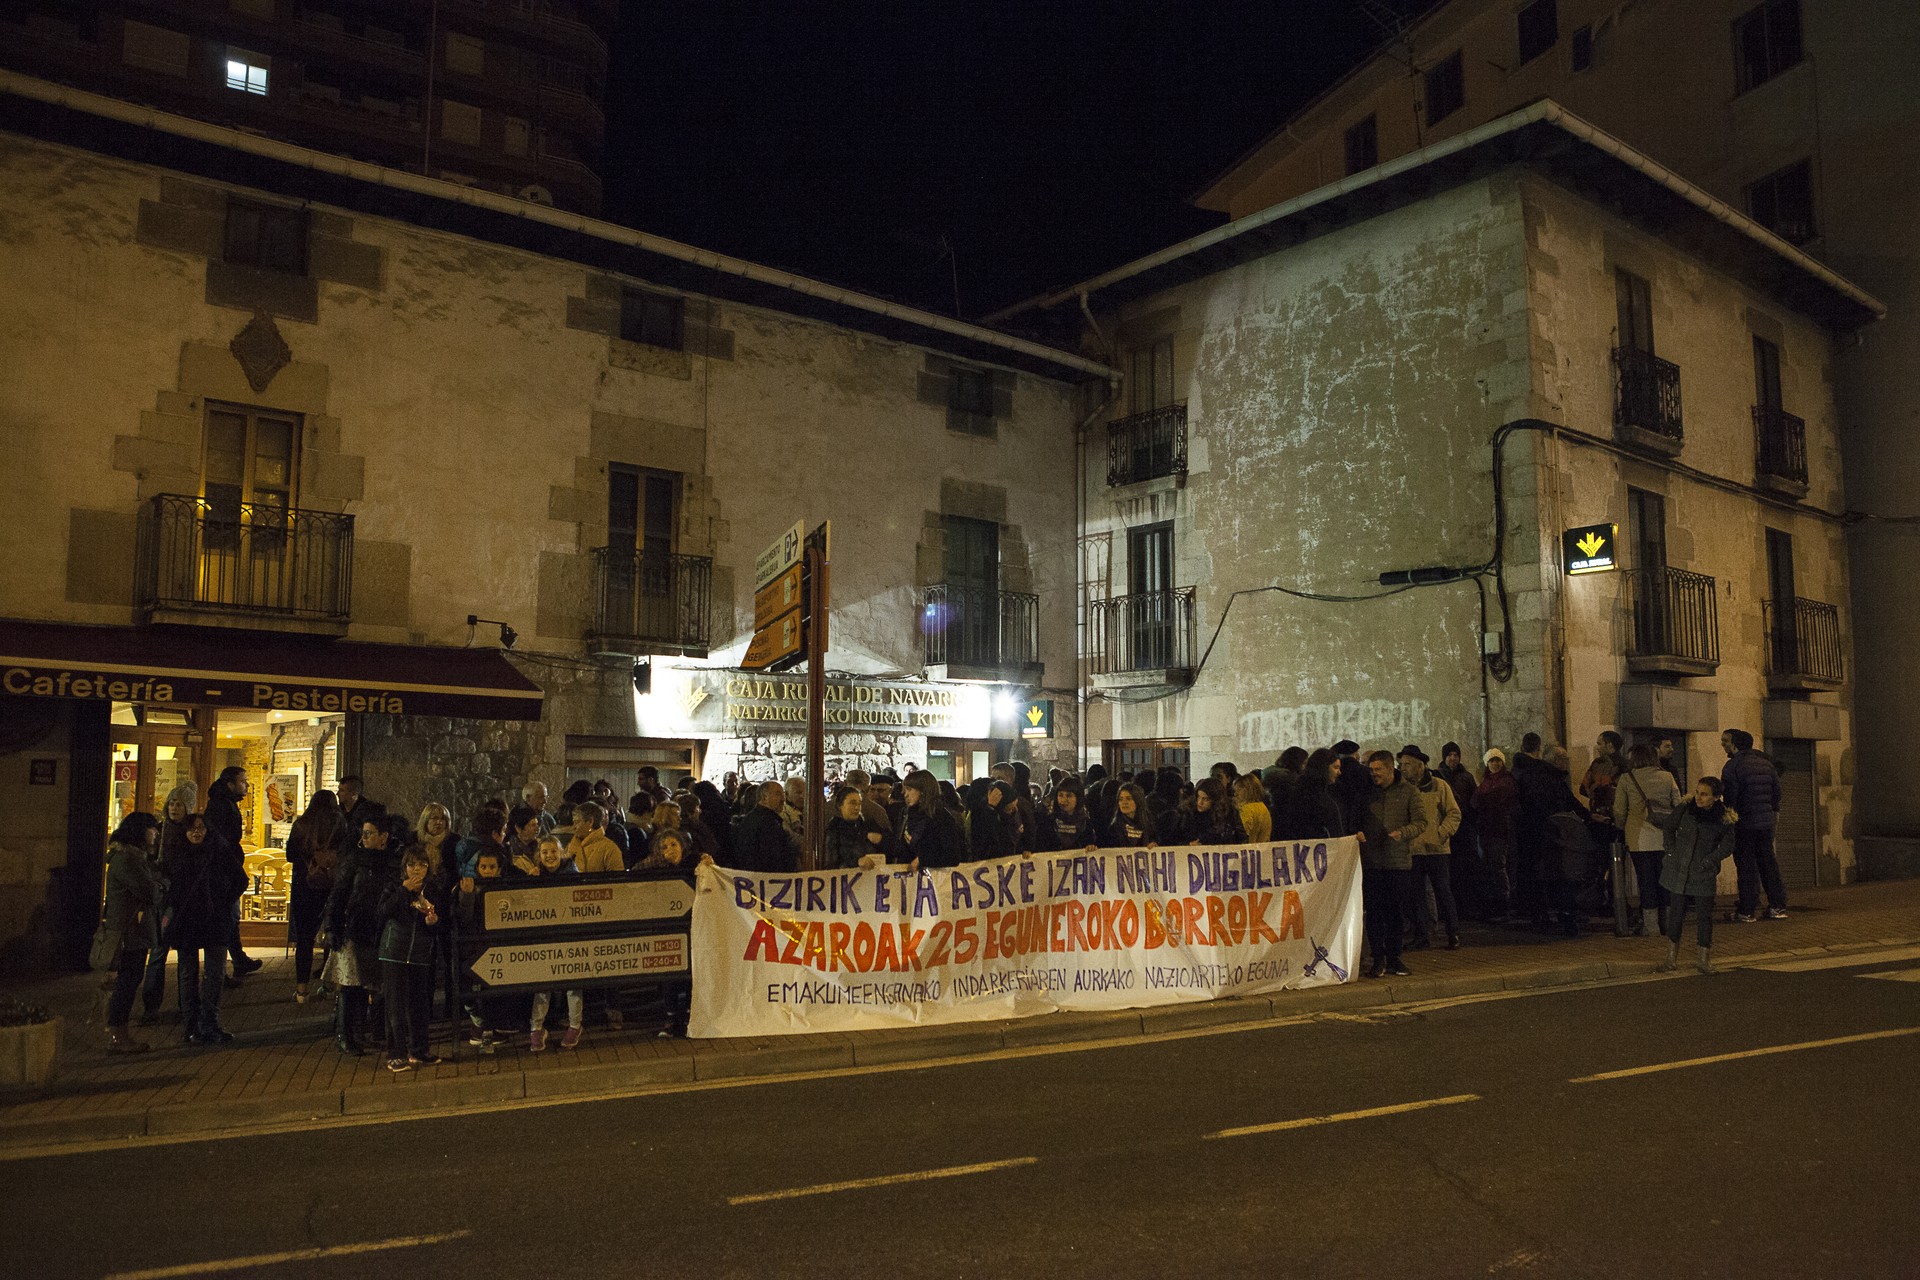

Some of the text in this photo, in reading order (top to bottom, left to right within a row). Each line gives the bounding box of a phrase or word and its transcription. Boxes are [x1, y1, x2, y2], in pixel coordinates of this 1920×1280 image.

[3, 667, 173, 703] Cafetería
[253, 684, 404, 714] Pastelería
[726, 679, 965, 706] CAJA RUAL DE NAVARR
[726, 703, 850, 723] NAFARROKO
[856, 709, 910, 725] RURAL
[733, 842, 1328, 919] BIZIRIK ETA ASKE IZAN NAHI DUGULAKO
[574, 890, 611, 901] N-240-A
[500, 908, 558, 923] PAMPLONA
[670, 901, 683, 912] 20
[743, 919, 926, 973] AZAROAK
[982, 898, 1140, 955] EGUNEROKO
[1143, 889, 1305, 950] BORROKA
[490, 952, 503, 965] 70
[593, 942, 651, 957] SEBASTIAN
[655, 941, 681, 951] N-130
[490, 969, 503, 980] 75
[643, 956, 682, 967] N-240-A
[1072, 967, 1136, 993] AURKAKO
[1144, 961, 1243, 991] NAZIOARTEKO
[1246, 958, 1290, 983] EGUNA
